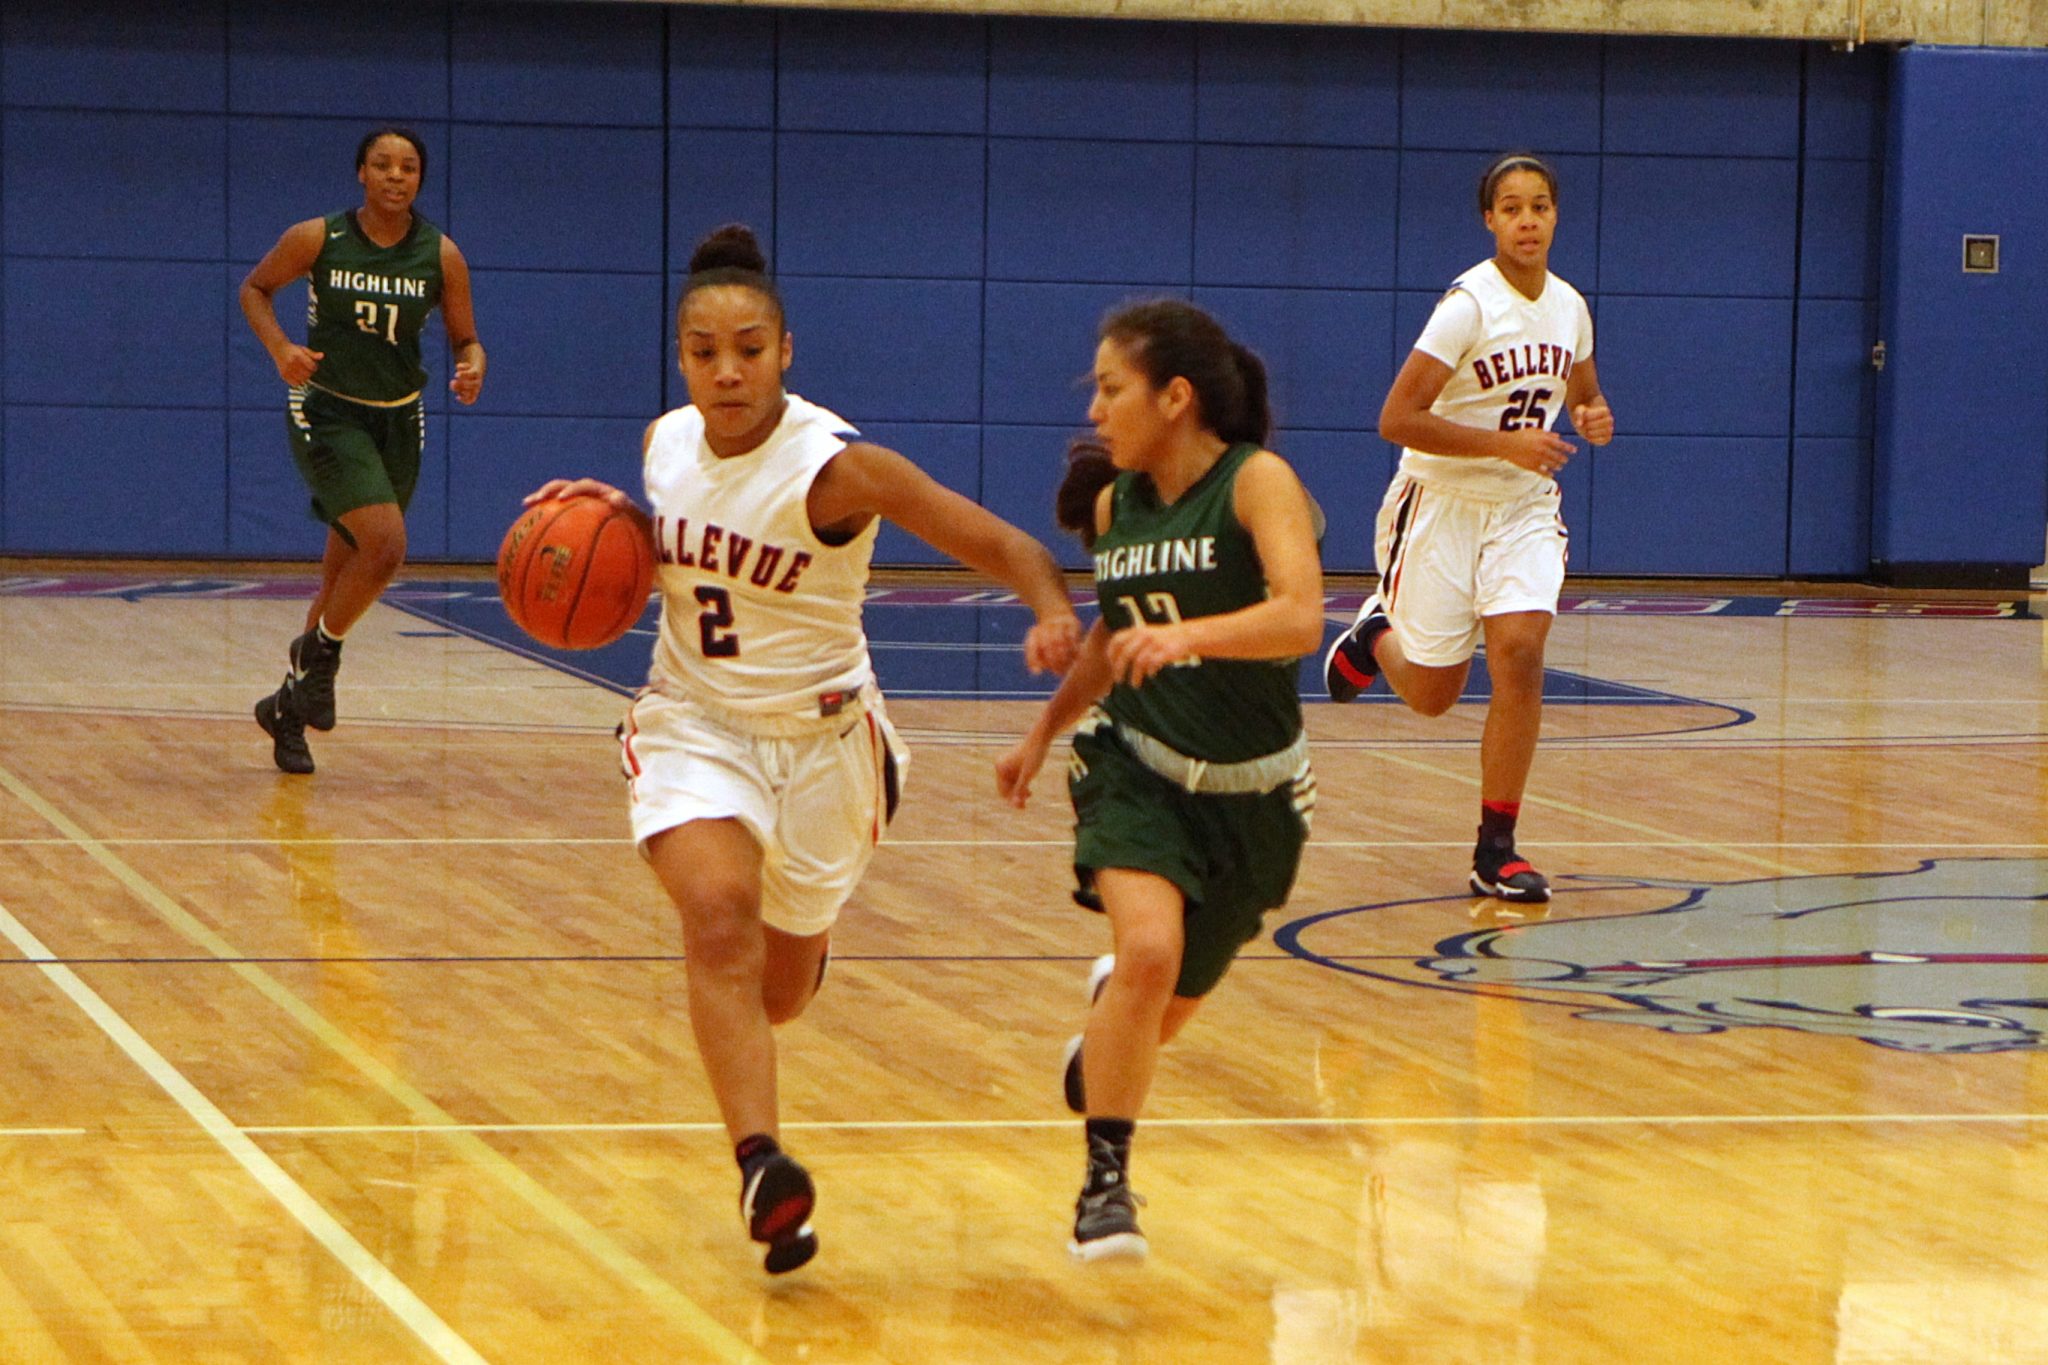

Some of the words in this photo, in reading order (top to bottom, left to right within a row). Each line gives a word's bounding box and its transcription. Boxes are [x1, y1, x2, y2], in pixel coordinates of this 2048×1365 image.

[330, 269, 427, 297] HIGHLINE
[1473, 343, 1574, 390] BELLEVU
[1499, 388, 1553, 432] 25
[653, 515, 812, 593] LLEVUE
[694, 585, 740, 658] 2
